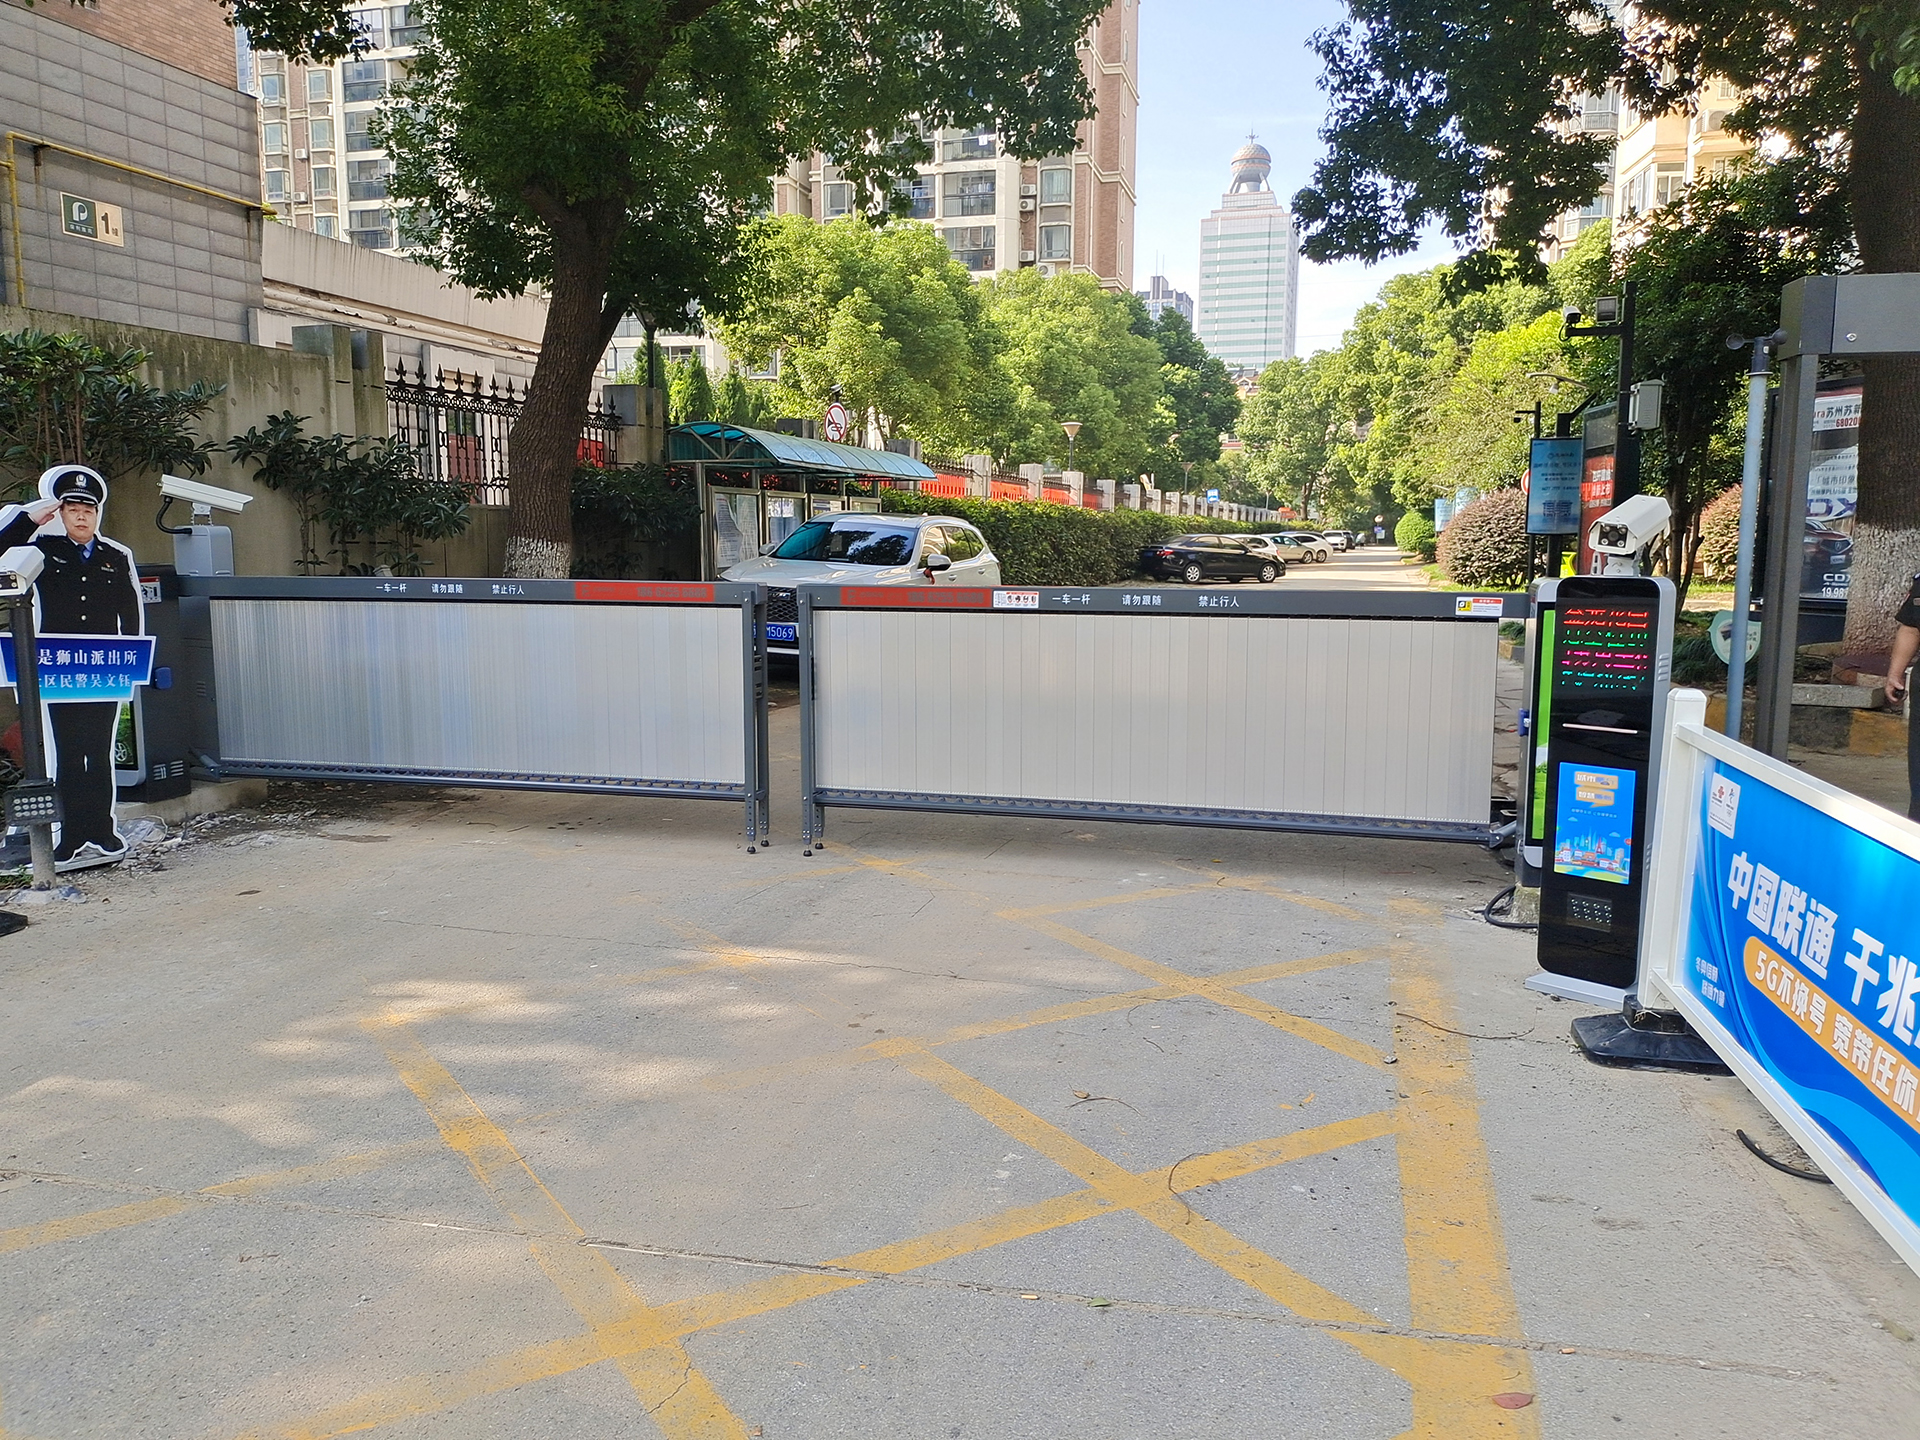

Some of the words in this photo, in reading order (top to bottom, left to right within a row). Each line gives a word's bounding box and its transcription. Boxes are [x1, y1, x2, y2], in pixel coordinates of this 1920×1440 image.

[375, 583, 407, 593] 一车一杆
[431, 583, 464, 594] 请勿跟随
[491, 584, 525, 595] 禁止行人
[1051, 593, 1091, 605] 一车一杆
[1122, 594, 1162, 606] 请勿跟随
[1198, 595, 1240, 607] 禁止行人
[39, 673, 132, 688] 区民警吴文钰
[1727, 851, 1838, 980] 中国联通
[1843, 927, 1920, 1050] 千兆
[1754, 950, 1827, 1034] 5G不换号
[1831, 1012, 1920, 1123] 宽带任你
